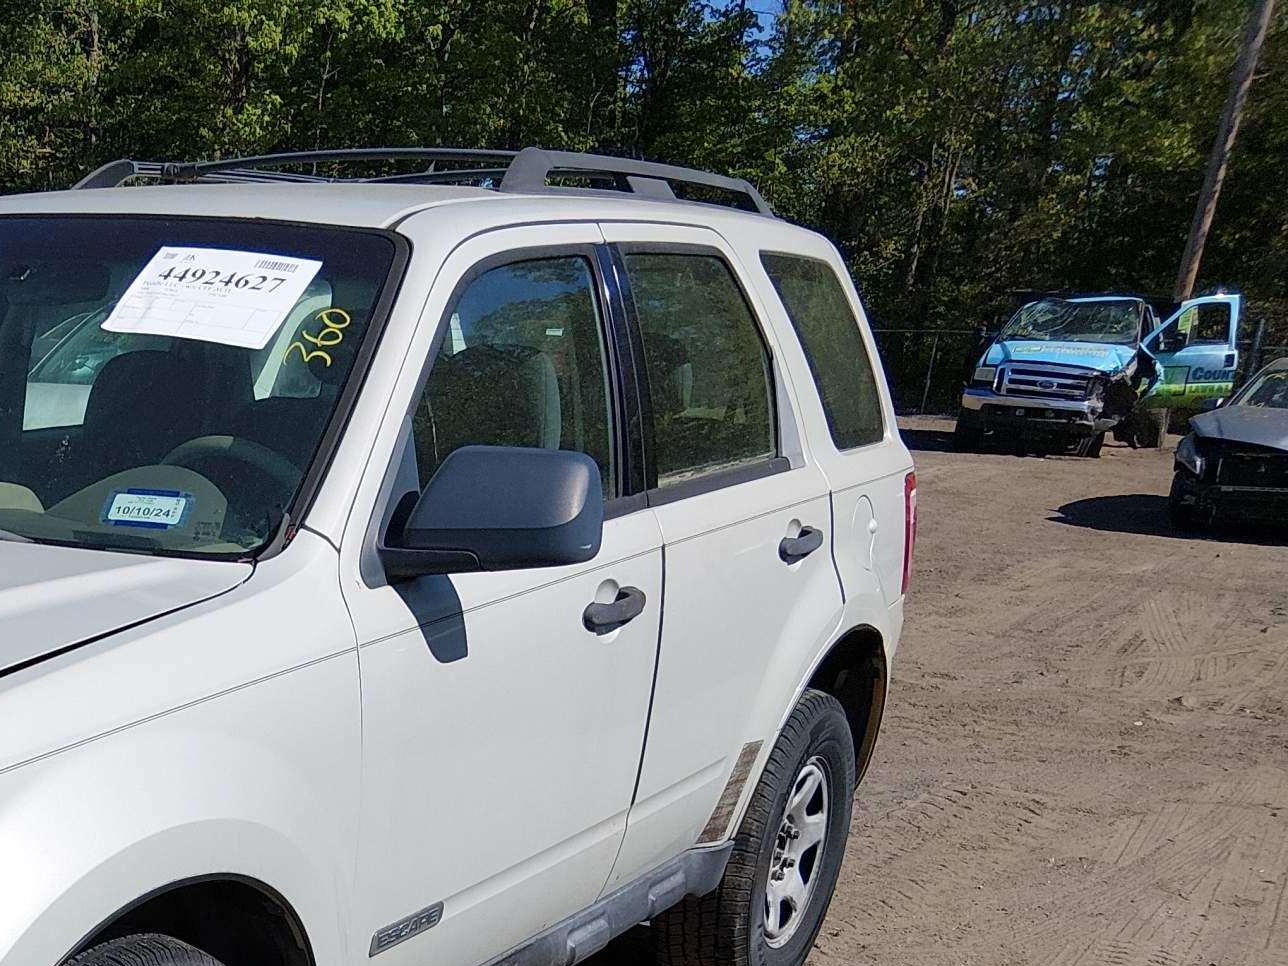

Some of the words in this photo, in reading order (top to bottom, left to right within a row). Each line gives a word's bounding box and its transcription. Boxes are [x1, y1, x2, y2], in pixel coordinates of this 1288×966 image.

[158, 266, 287, 293] 44924627
[283, 308, 351, 367] 360
[116, 506, 171, 518] 10/10/24
[377, 906, 441, 949] ESCAPE
